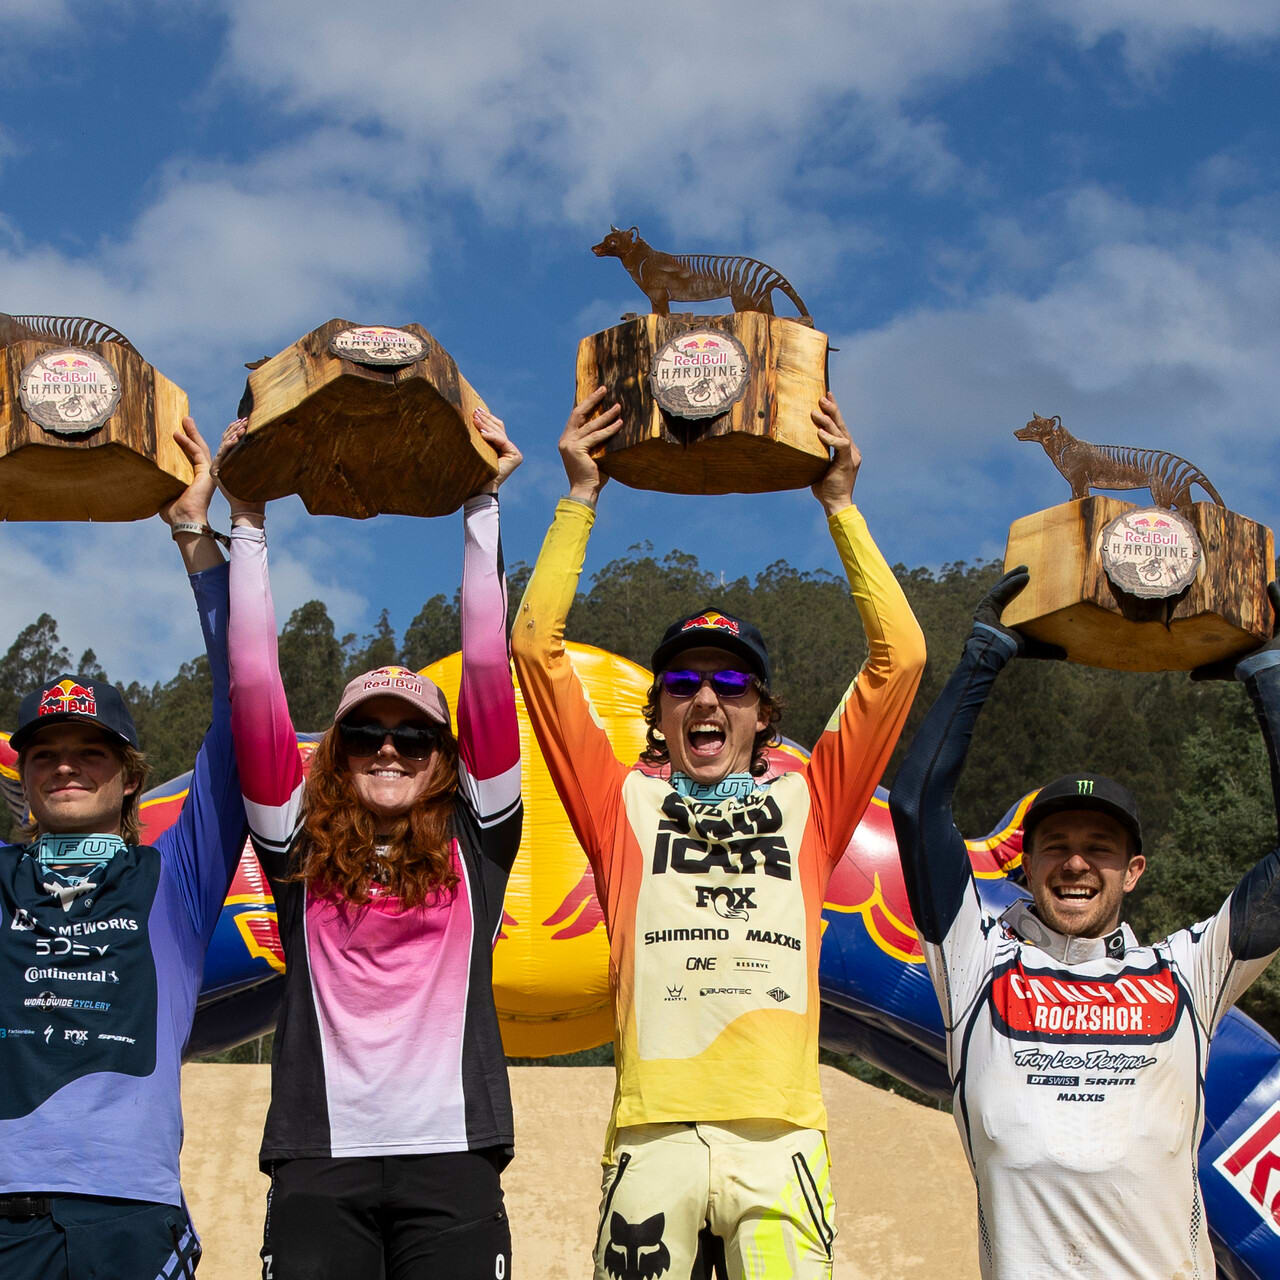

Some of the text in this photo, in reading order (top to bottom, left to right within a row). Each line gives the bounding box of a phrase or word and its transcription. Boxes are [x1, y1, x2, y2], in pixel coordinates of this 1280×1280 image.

[674, 352, 727, 366] Red Bull
[43, 372, 96, 382] Red Bull
[661, 365, 737, 379] HARDLINE
[31, 384, 108, 395] HARDLINE
[1125, 531, 1178, 545] Red Bull
[1112, 543, 1189, 558] HARDLINE
[363, 679, 423, 695] Red Bull
[38, 700, 97, 716] Red Bull
[695, 886, 757, 915] FOX
[644, 928, 729, 945] SHIMANO
[746, 929, 802, 951] MAXXIS
[736, 961, 769, 969] RESERVE
[24, 967, 106, 983] Continental
[704, 987, 752, 996] BURGTEC
[1010, 973, 1176, 1005] CANYON
[73, 999, 112, 1011] CYCLERY
[1034, 1005, 1143, 1031] ROCKSHOX
[64, 1030, 89, 1044] FOX
[1014, 1049, 1157, 1070] Troy Lee Designs
[1030, 1076, 1076, 1085] DT SWISS
[1057, 1093, 1105, 1102] MAXXIS
